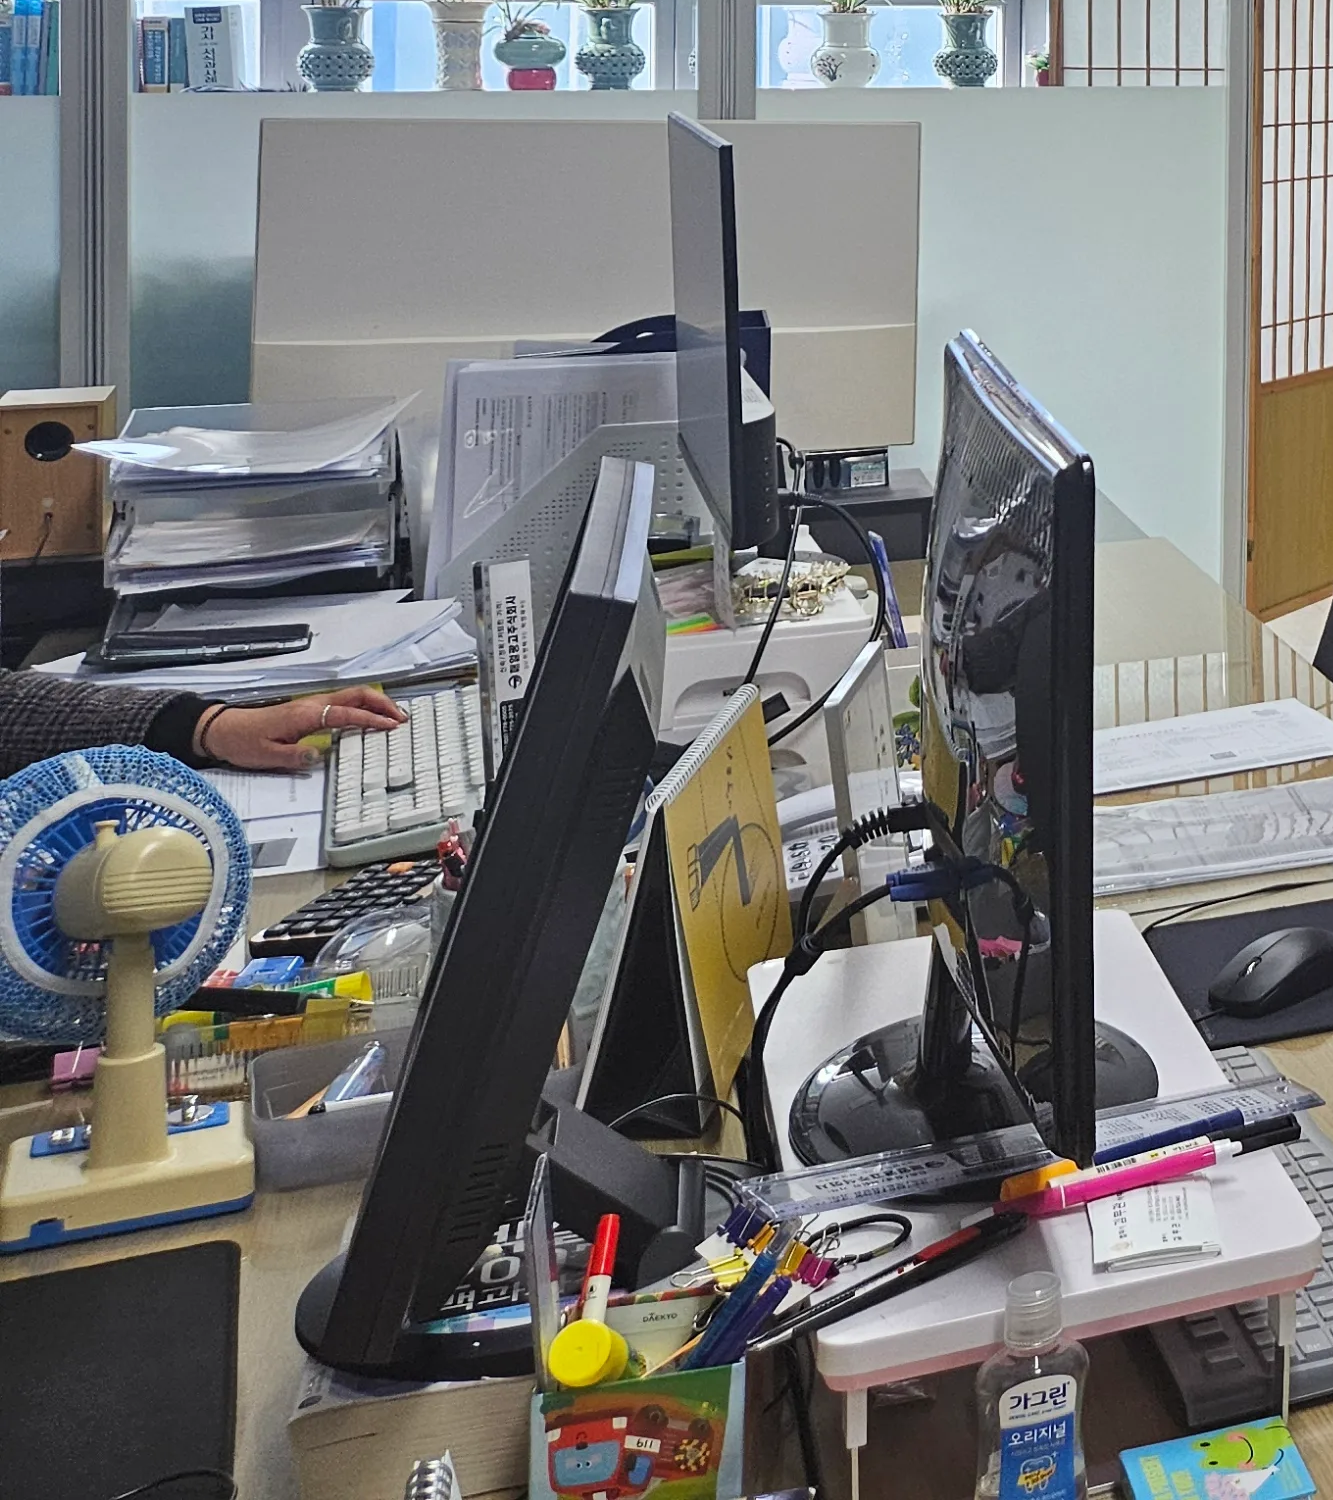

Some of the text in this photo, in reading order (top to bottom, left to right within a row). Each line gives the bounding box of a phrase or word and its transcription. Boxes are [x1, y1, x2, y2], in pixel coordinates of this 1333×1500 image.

[642, 1312, 678, 1324] DAEKYO
[1009, 1382, 1068, 1411] 가그린
[1008, 1420, 1066, 1446] 오리지널
